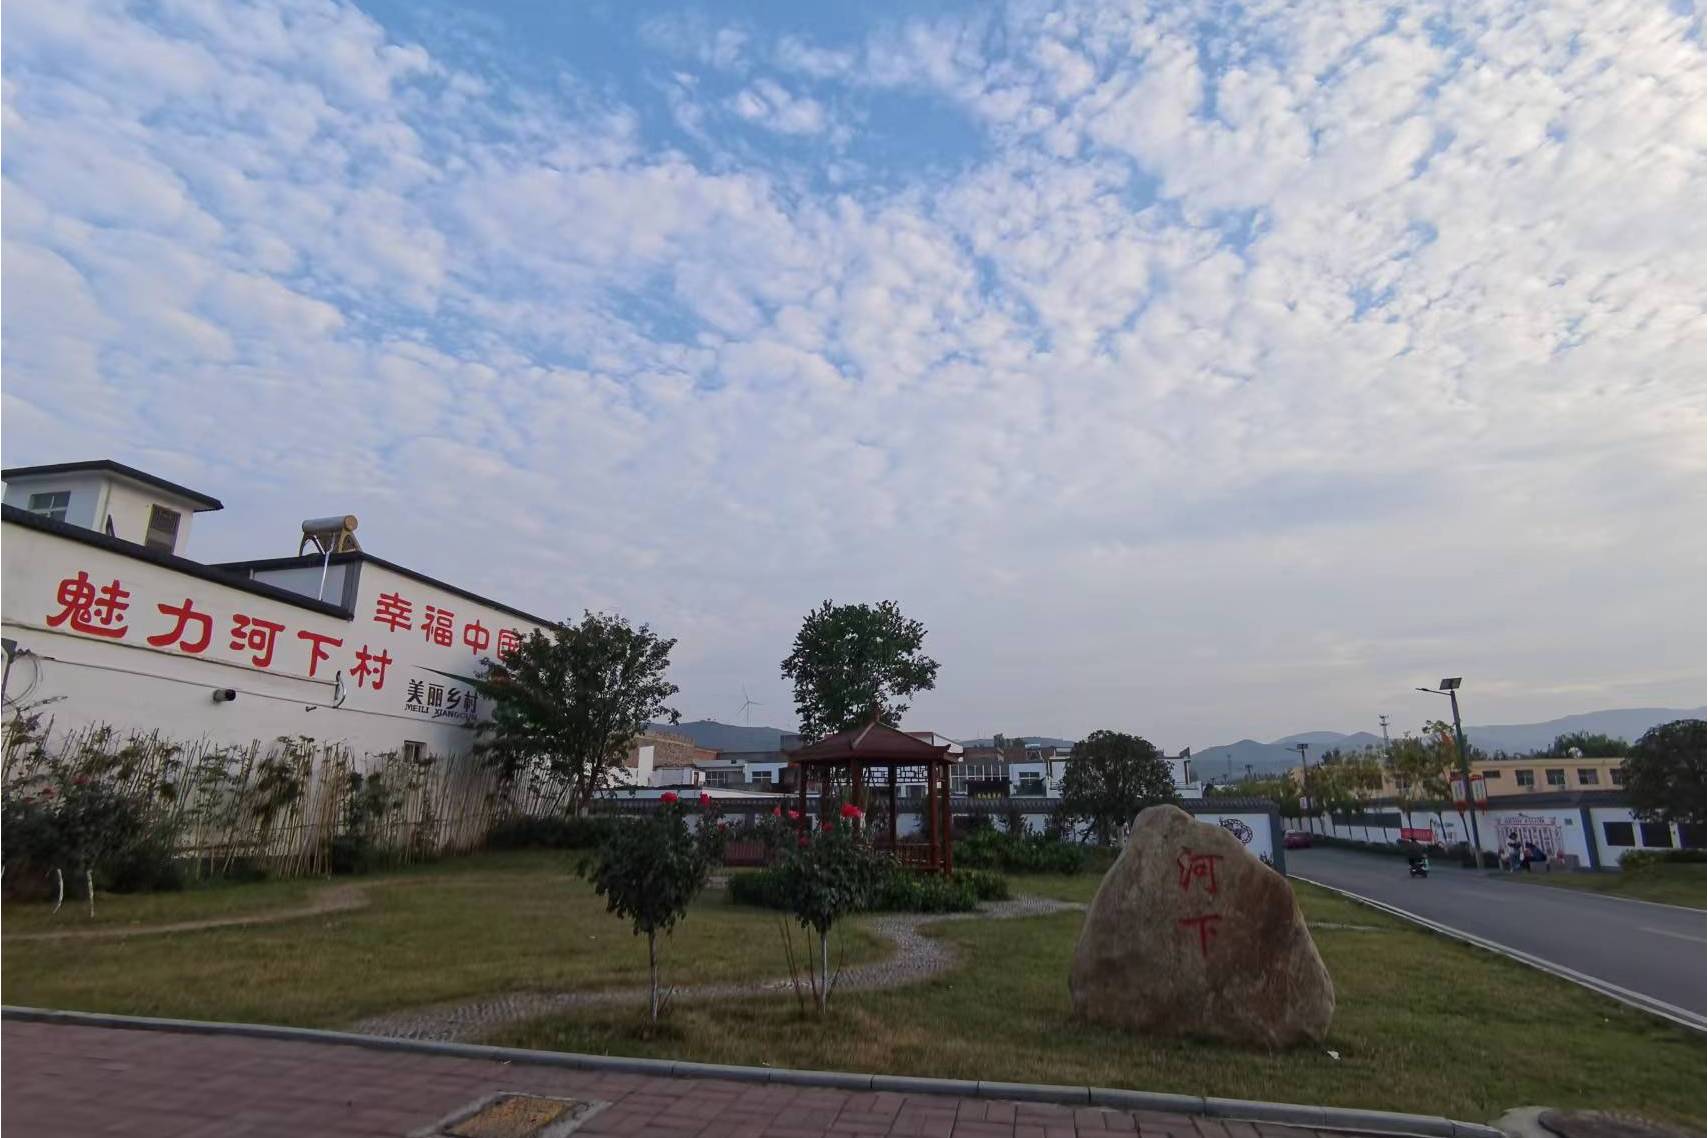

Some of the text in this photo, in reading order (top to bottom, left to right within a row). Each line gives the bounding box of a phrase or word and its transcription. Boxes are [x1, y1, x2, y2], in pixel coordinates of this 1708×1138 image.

[46, 571, 393, 690] 魅力河下村
[372, 592, 521, 663] 幸福中国
[404, 703, 430, 714] MEILI
[406, 678, 479, 713] 美丽乡村
[1177, 846, 1223, 958] 河下
